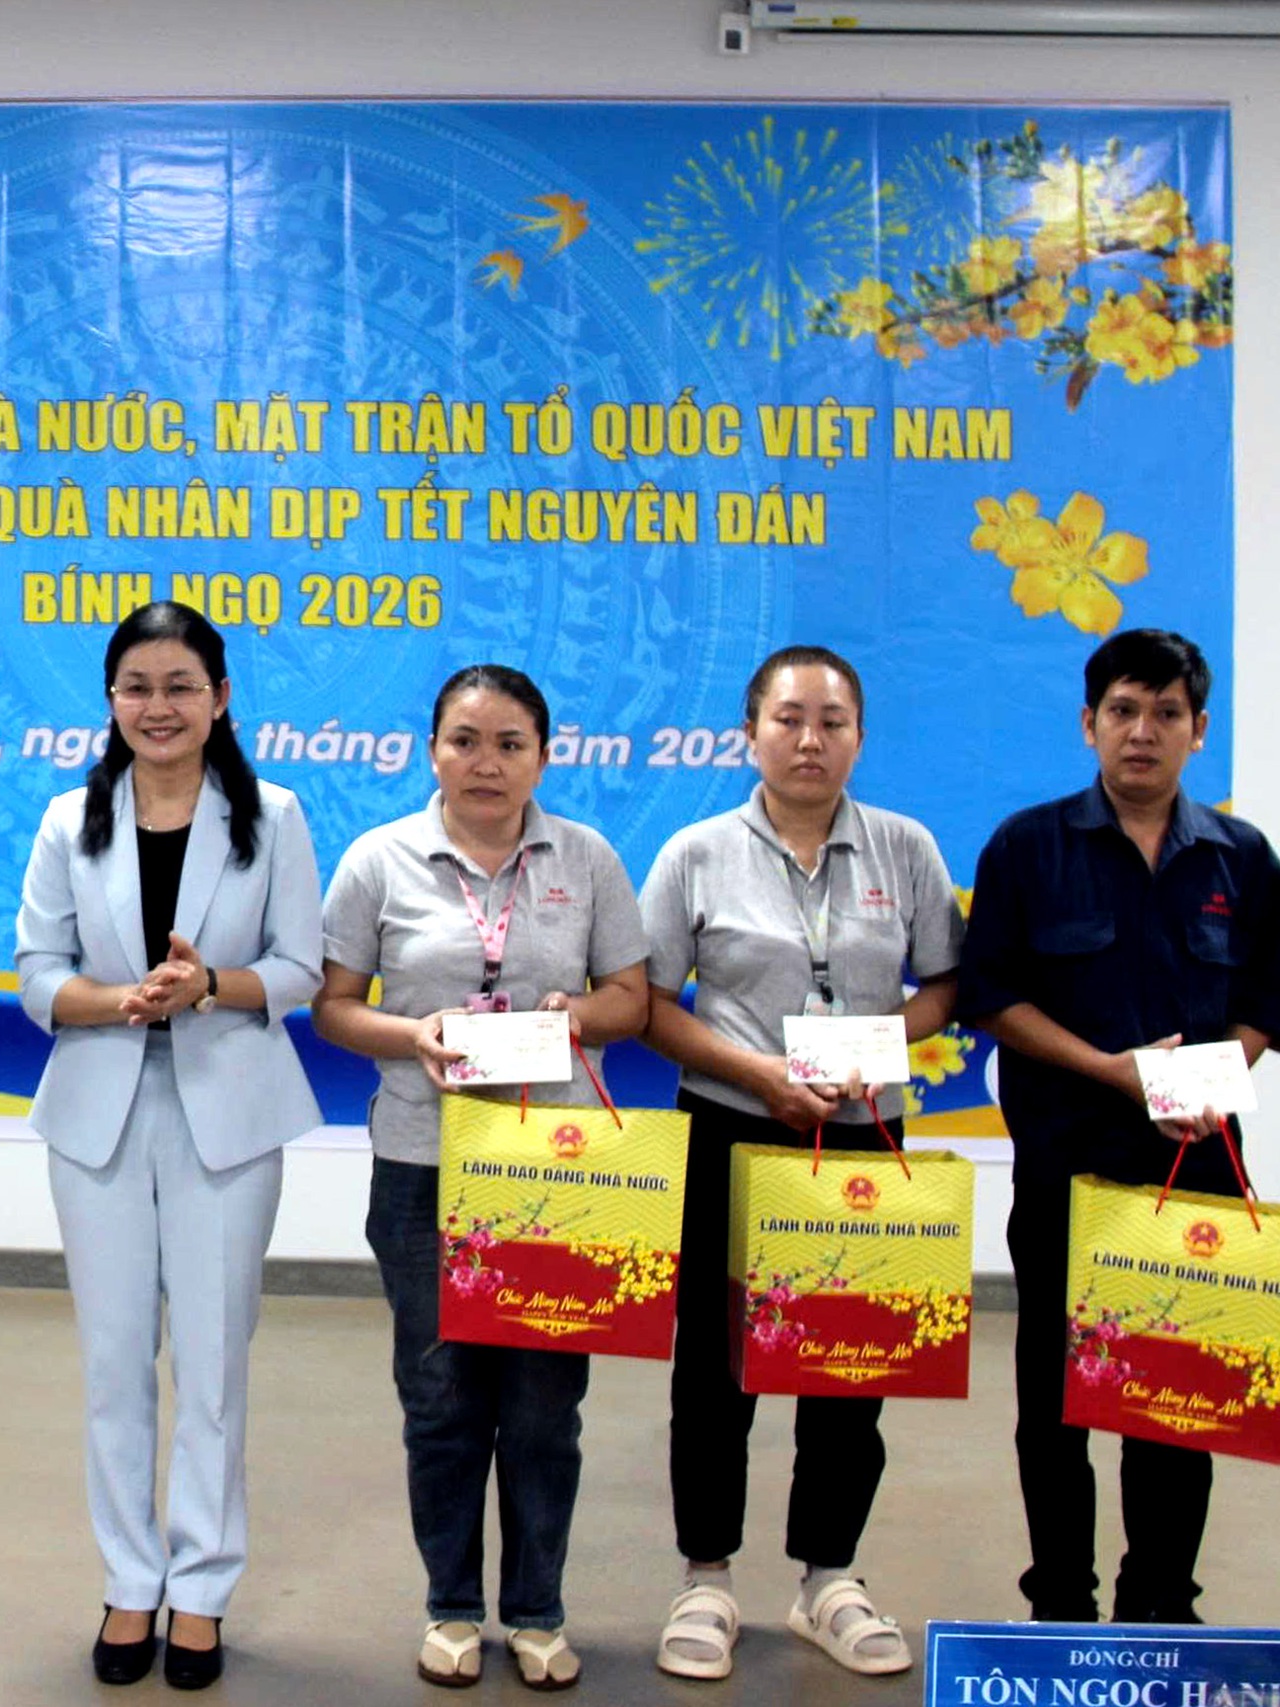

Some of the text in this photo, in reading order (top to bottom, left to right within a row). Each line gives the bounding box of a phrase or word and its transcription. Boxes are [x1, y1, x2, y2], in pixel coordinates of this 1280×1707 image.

[38, 390, 197, 457] NƯỚC,
[215, 390, 330, 464] MẶT
[346, 392, 486, 464] TRẬN
[505, 384, 574, 456] TỔ
[591, 386, 741, 462] QUỐC
[758, 396, 876, 470] VIỆT
[893, 406, 1013, 461] NAM
[108, 477, 251, 539] NHÂN
[270, 486, 361, 550] DỊP
[376, 469, 471, 542] TẾT
[488, 481, 697, 545] NGUYÊN
[716, 483, 826, 545] ĐÁN
[23, 562, 443, 636] BÍNH NGỌ 2026
[255, 718, 414, 773] tháng
[548, 724, 631, 766] ăm
[647, 727, 758, 768] 202
[955, 1667, 1040, 1705] TÔN
[1139, 1648, 1179, 1668] CHÍ
